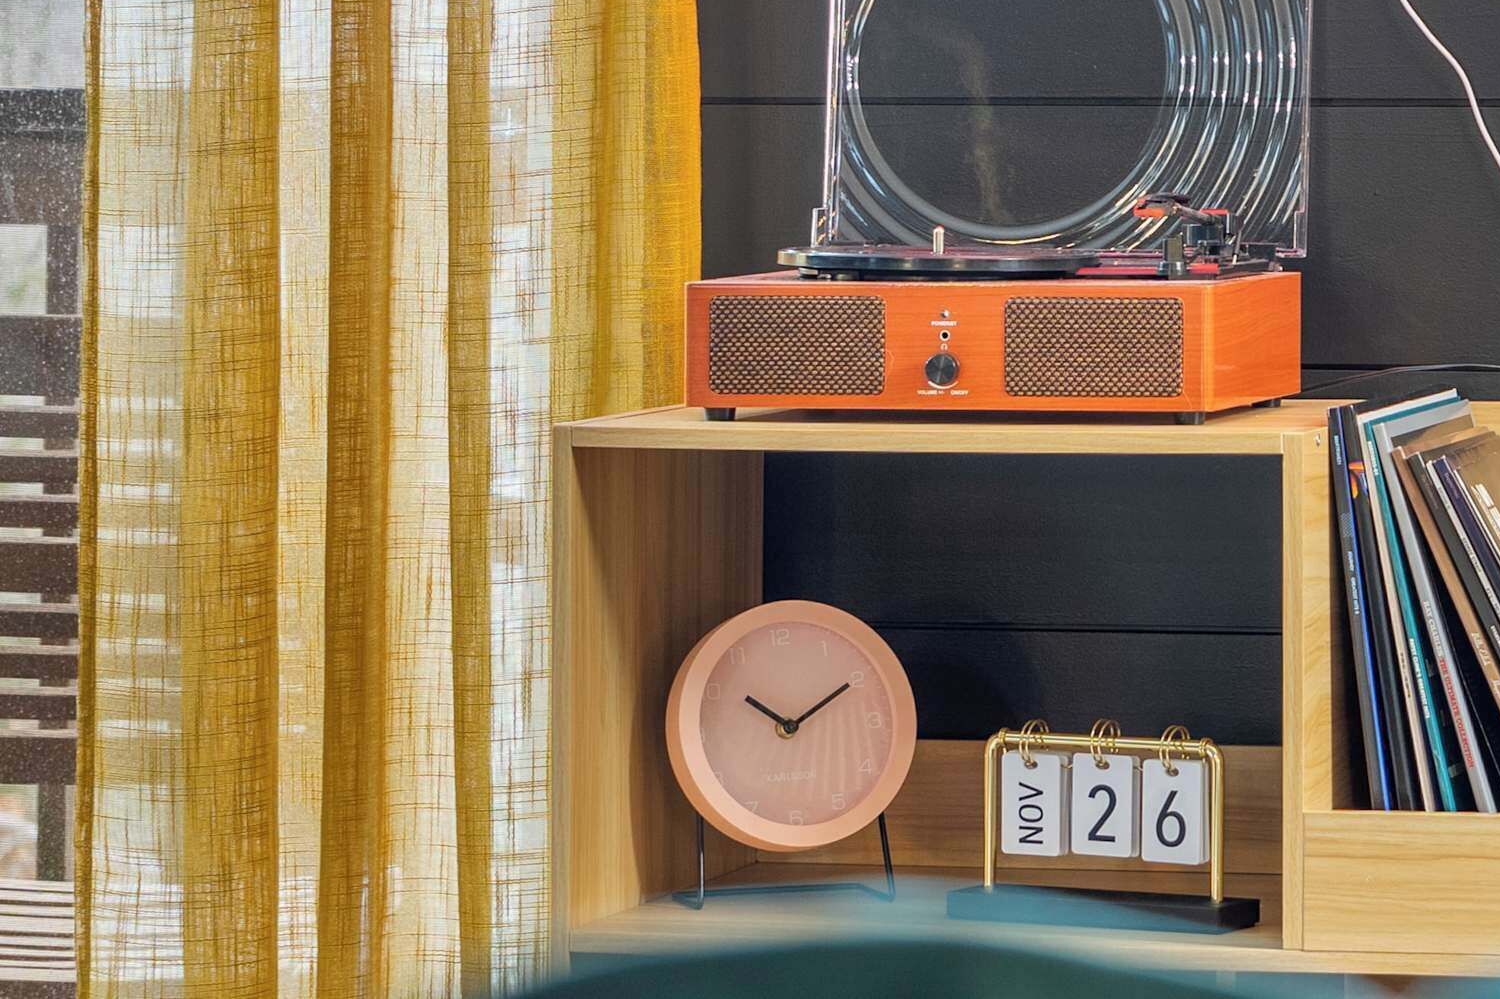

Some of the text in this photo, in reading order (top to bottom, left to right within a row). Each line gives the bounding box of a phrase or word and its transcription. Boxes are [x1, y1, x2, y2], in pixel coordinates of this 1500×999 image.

[769, 628, 791, 648] 12
[729, 646, 748, 666] 11
[816, 639, 829, 657] 1
[848, 670, 866, 688] 2
[865, 711, 882, 729] 3
[1455, 718, 1474, 768] COLLECTION
[856, 758, 873, 775] 4
[831, 793, 847, 811] 5
[1018, 781, 1187, 848] NOV 2 6
